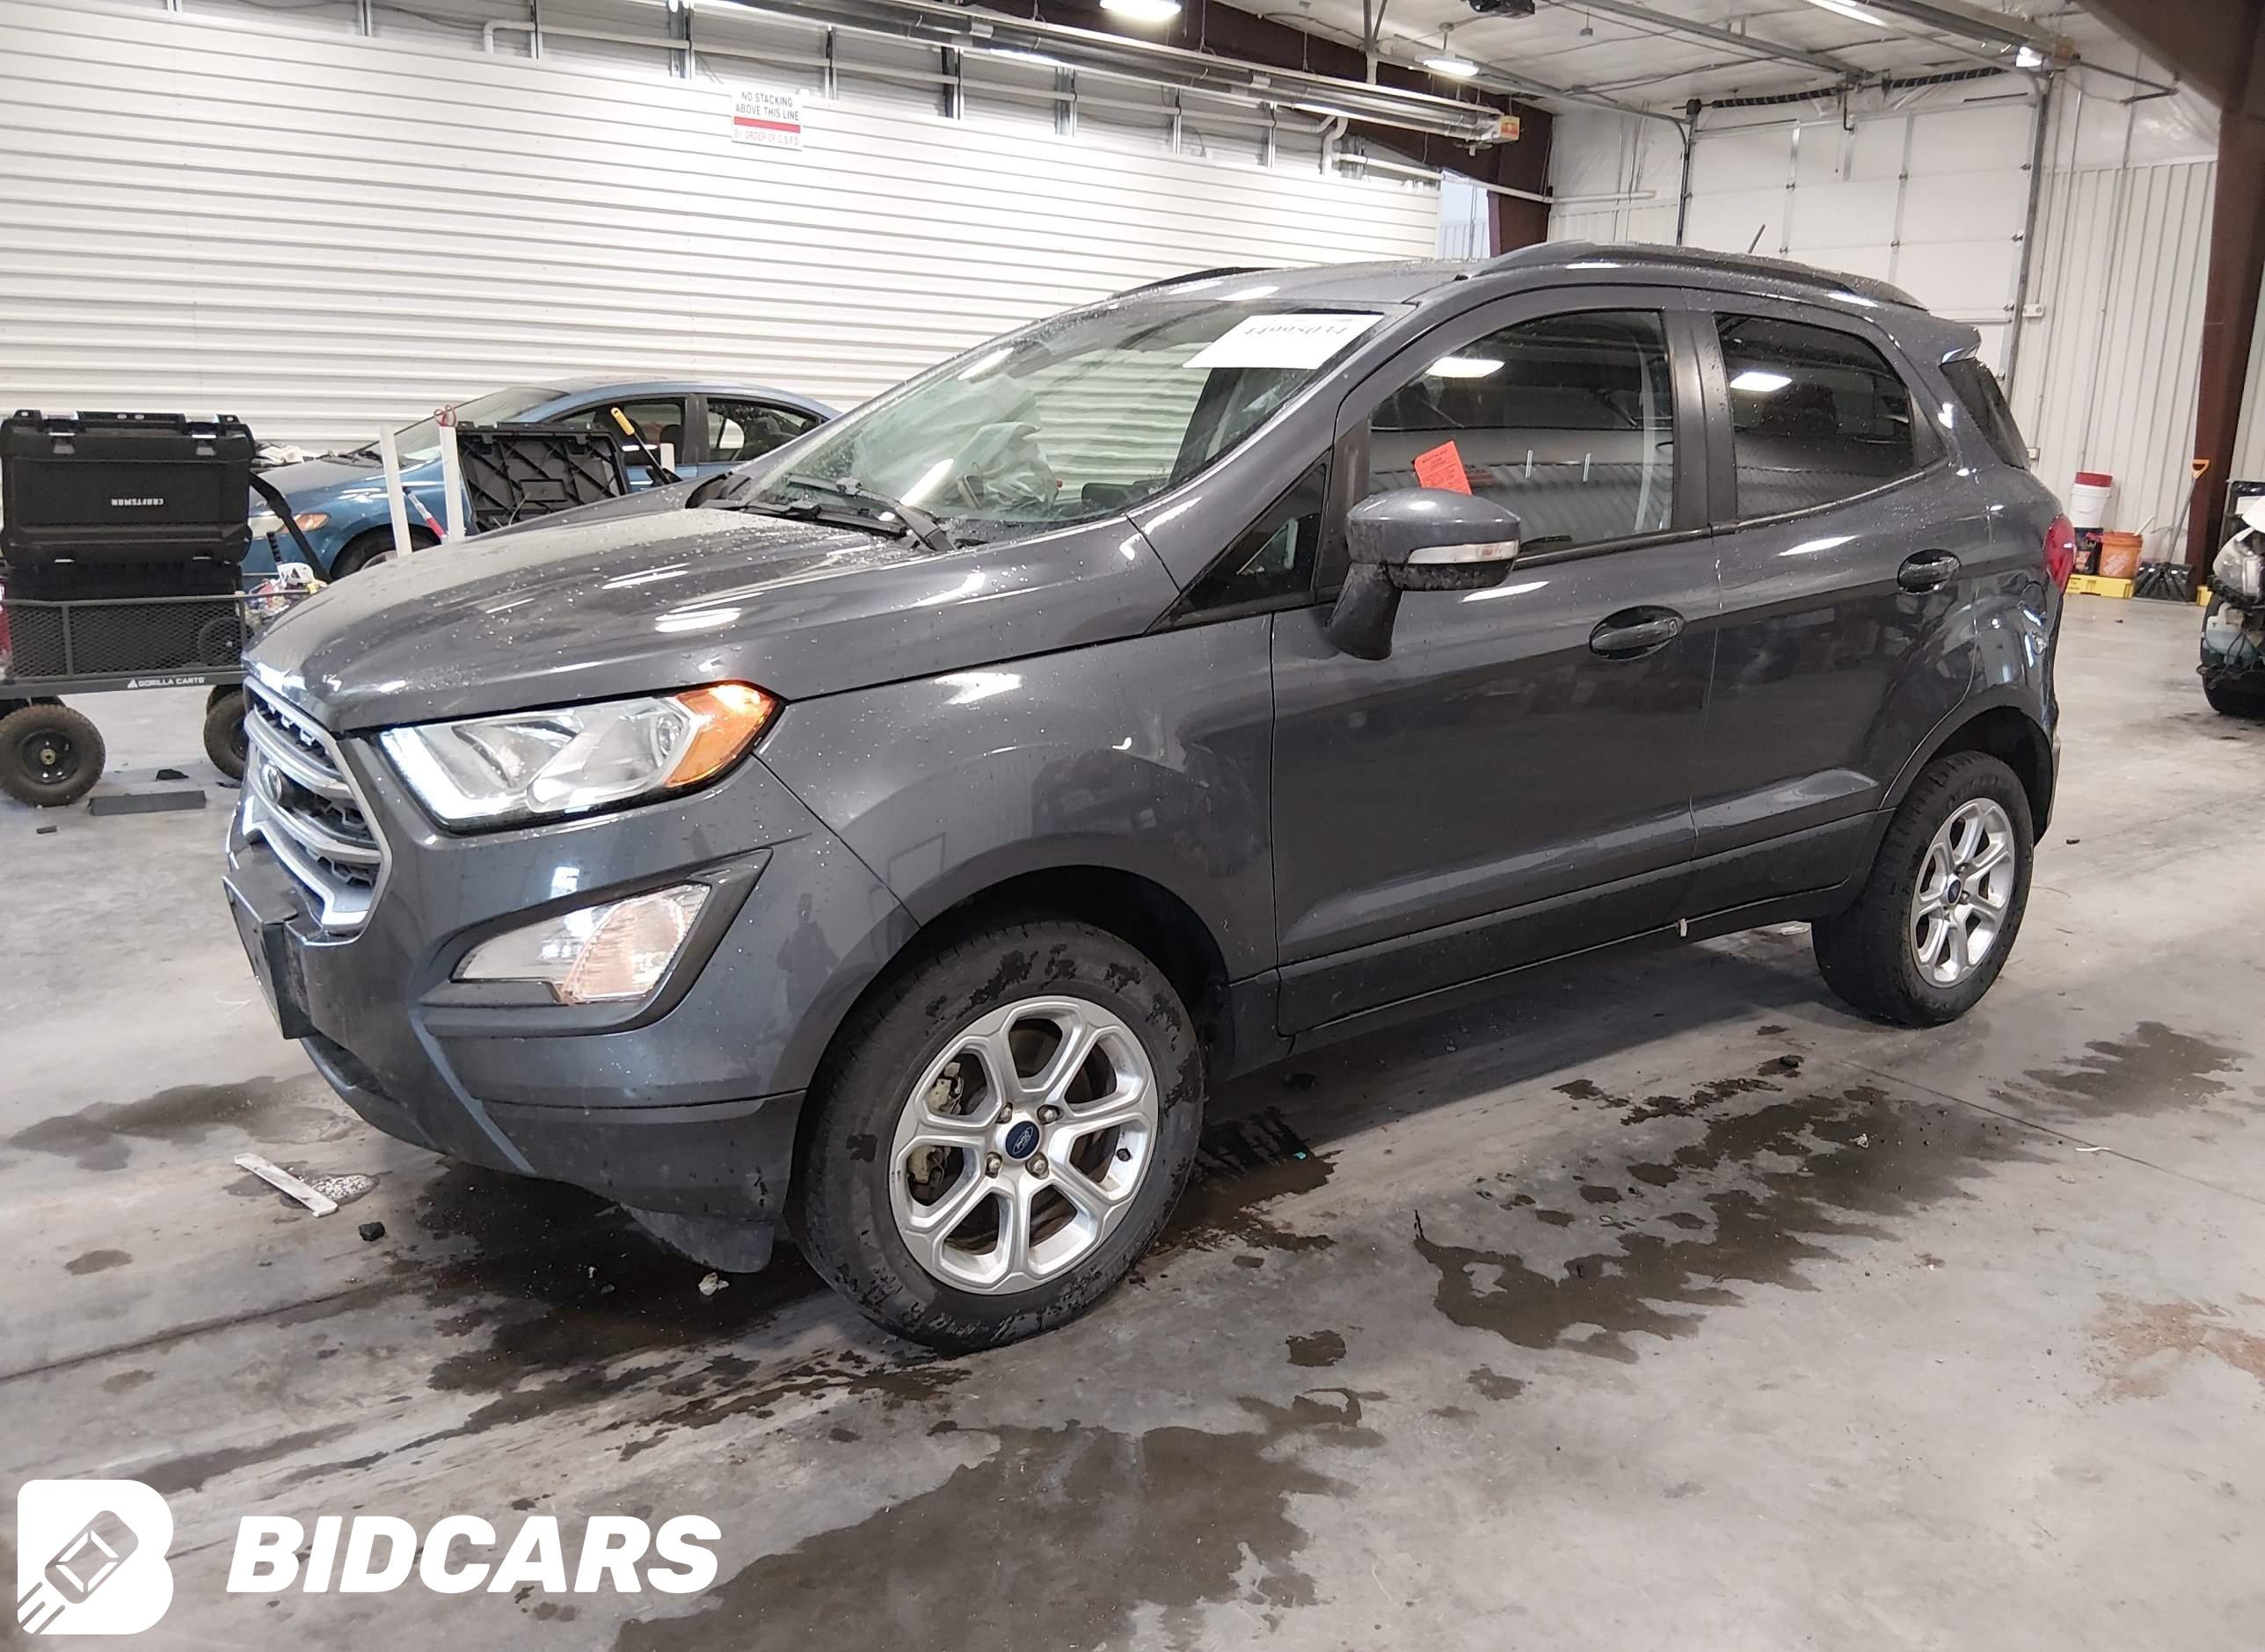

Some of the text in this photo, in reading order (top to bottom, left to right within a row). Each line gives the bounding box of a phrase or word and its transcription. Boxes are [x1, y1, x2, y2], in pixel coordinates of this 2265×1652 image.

[741, 91, 793, 107] NO STACKING
[736, 103, 799, 121] ABOVE THIS LINE
[112, 498, 164, 506] CRAFTSMAN
[138, 676, 206, 688] GORILLA CARTS
